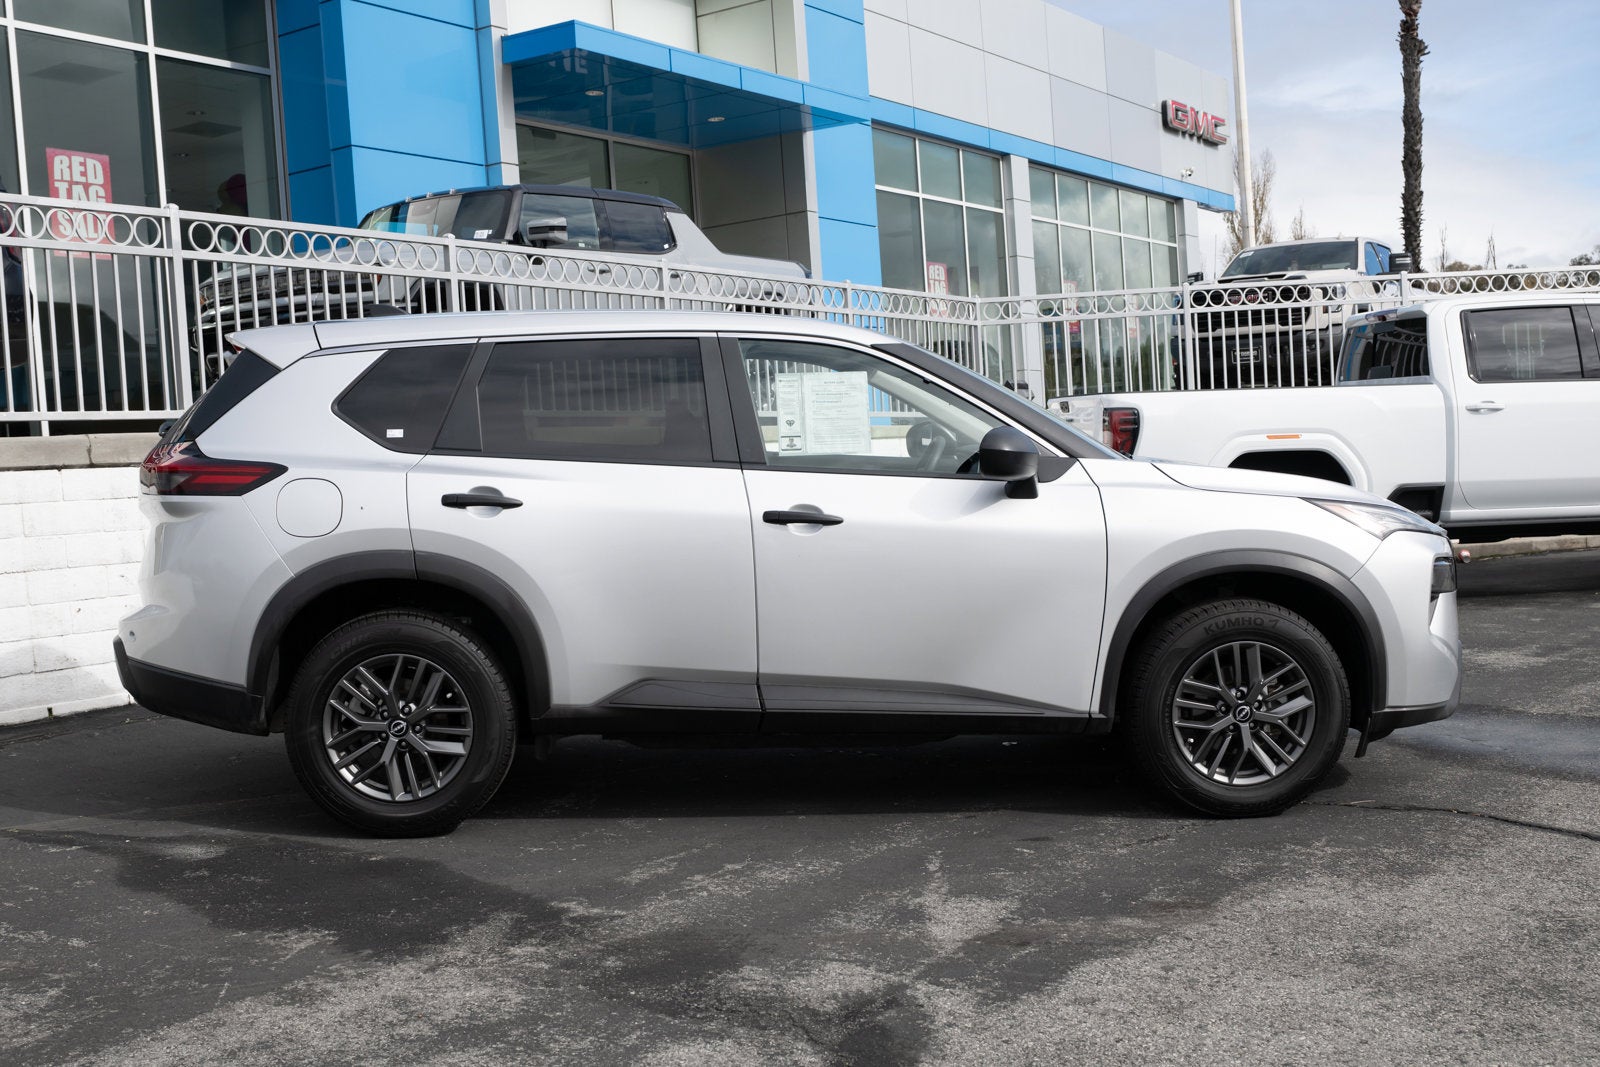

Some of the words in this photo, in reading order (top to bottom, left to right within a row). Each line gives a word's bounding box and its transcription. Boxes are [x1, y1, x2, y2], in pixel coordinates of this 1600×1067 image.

[1165, 100, 1227, 144] GMC
[53, 155, 104, 185] RED
[929, 264, 945, 281] RED
[1203, 616, 1265, 636] KUMHO
